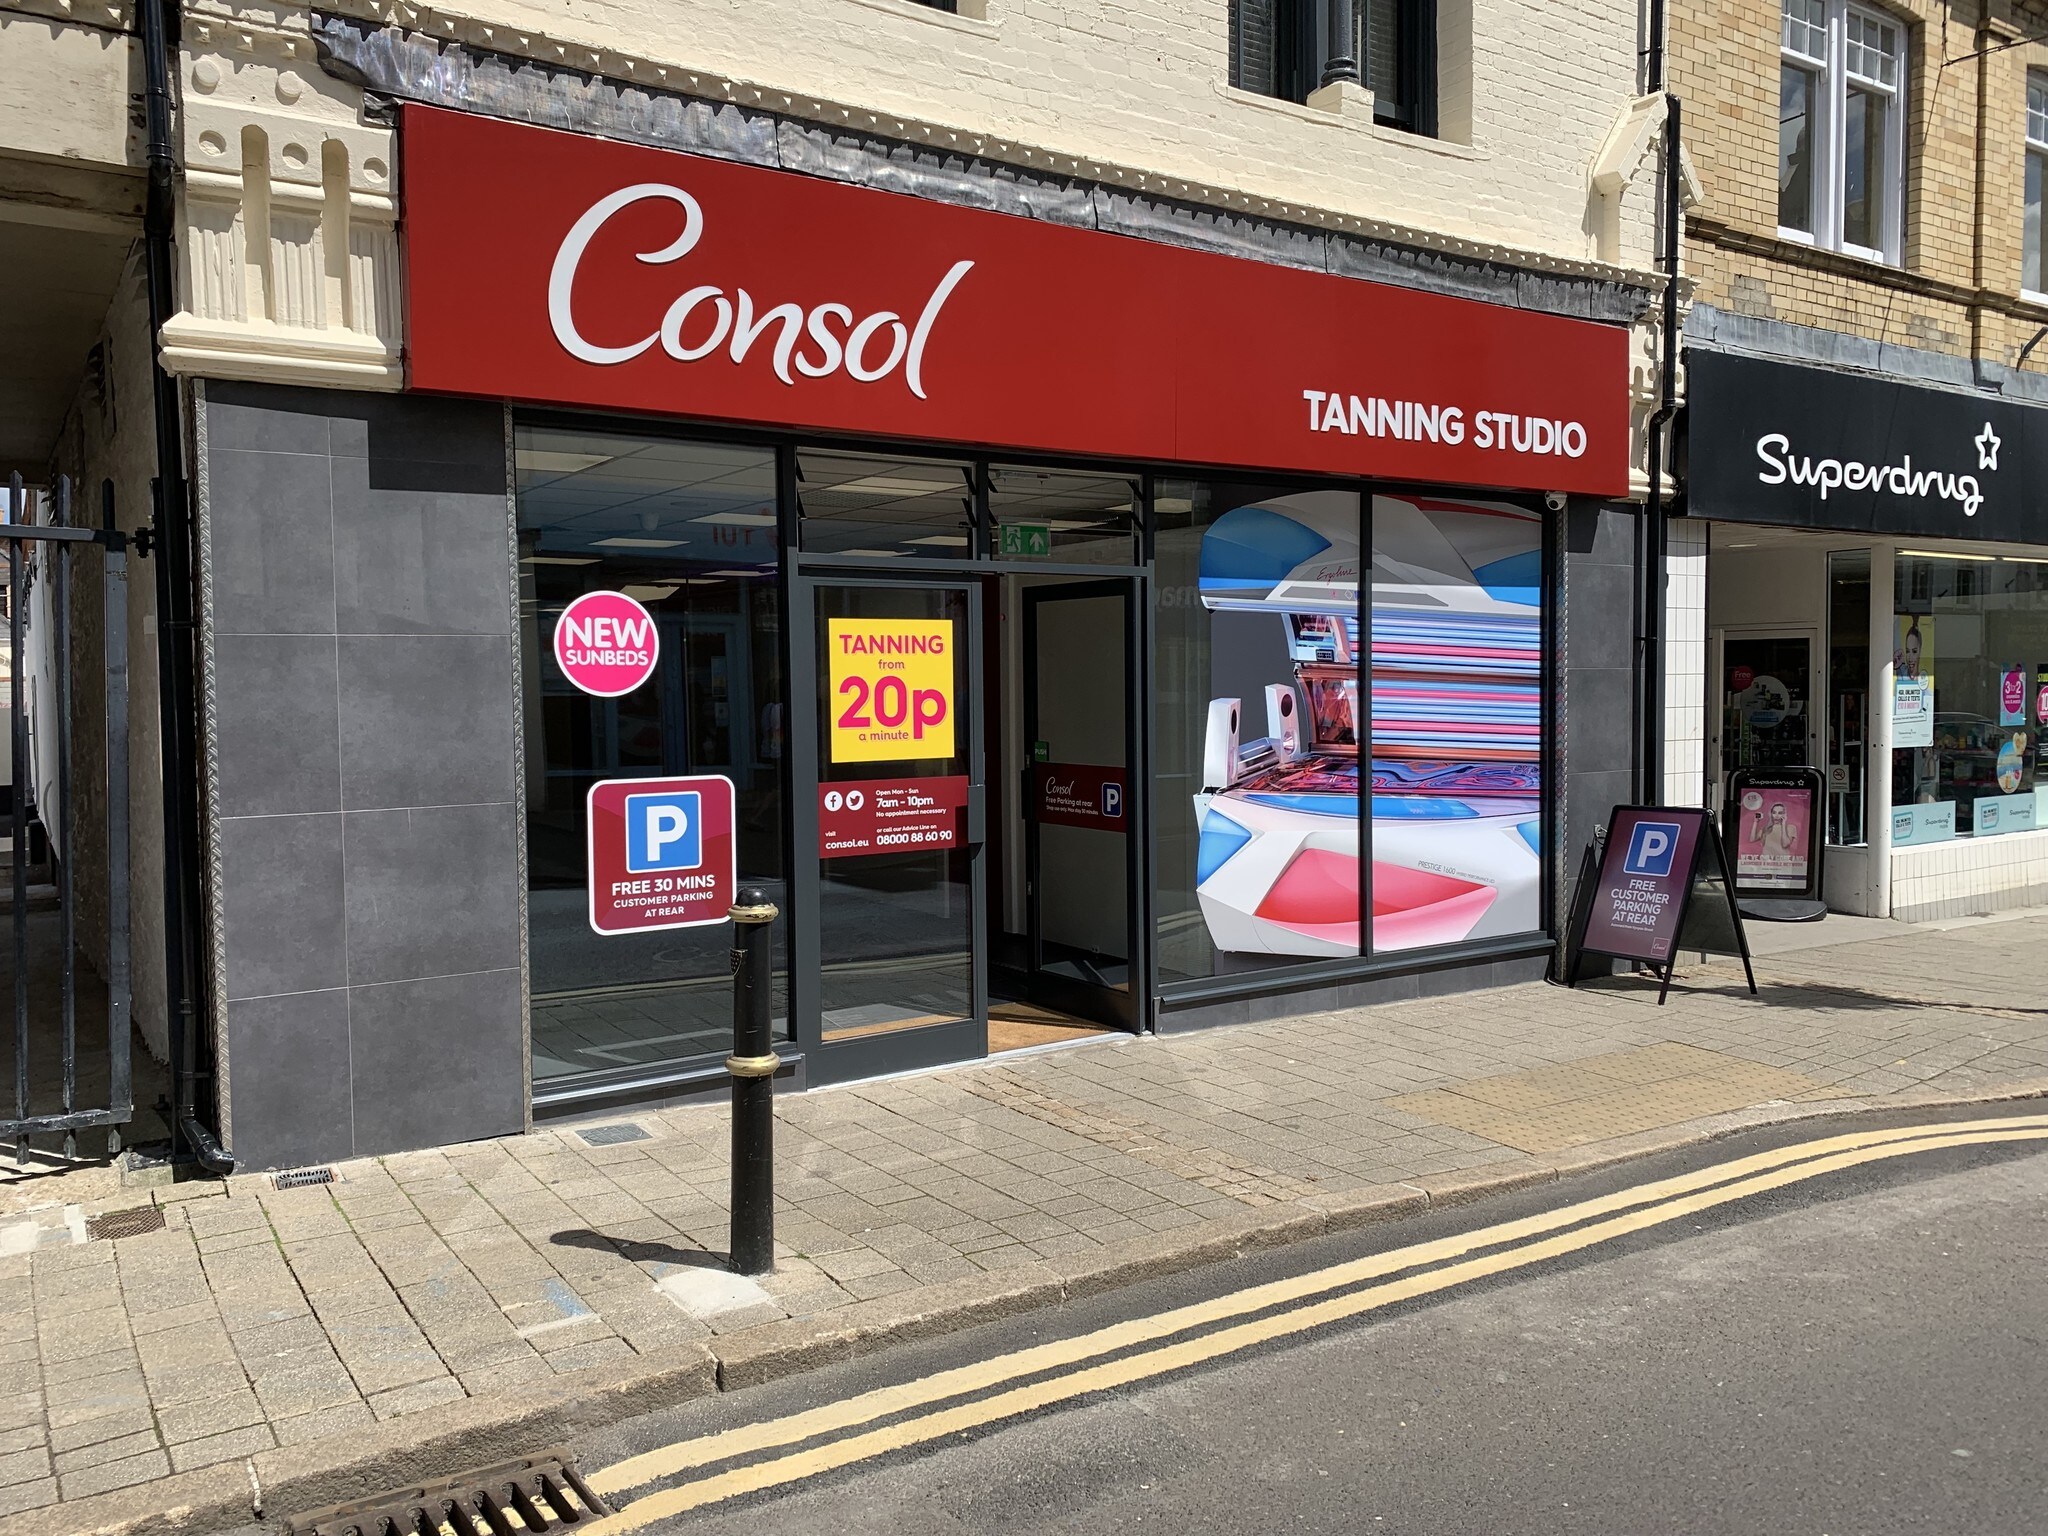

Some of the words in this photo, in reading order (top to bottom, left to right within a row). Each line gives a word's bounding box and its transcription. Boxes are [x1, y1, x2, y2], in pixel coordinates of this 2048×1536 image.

[548, 183, 975, 399] Consol
[1303, 389, 1465, 446] TANNING
[1473, 410, 1588, 459] STUDIO
[1756, 433, 1984, 517] Superdrug
[565, 616, 648, 649] NEW
[839, 634, 944, 655] TANNING
[565, 650, 649, 667] SUNBEDS
[878, 659, 905, 670] from
[838, 675, 947, 740] 20p
[858, 733, 867, 741] a
[870, 730, 909, 741] minute
[1035, 748, 1047, 756] PUSH
[1046, 776, 1074, 795] Consol
[1749, 778, 1795, 786] Superdrug
[876, 789, 891, 797] Open
[1106, 788, 1119, 812] P
[876, 797, 899, 808] 7am
[907, 796, 934, 808] 10pm
[1046, 796, 1056, 804] Free
[1057, 797, 1075, 807] Parking
[885, 809, 919, 818] appointment
[920, 808, 946, 816] necessary
[646, 805, 688, 862] P
[876, 834, 909, 846] 08000
[911, 832, 923, 842] 88
[925, 831, 938, 841] 60
[939, 830, 952, 841] 90
[825, 839, 869, 850] consol.eu
[1637, 830, 1669, 868] P
[1418, 860, 1442, 872] PRESTIGE
[1443, 866, 1456, 875] 1600
[612, 880, 650, 896] FREE
[654, 878, 673, 892] 30
[676, 874, 715, 890] MINS
[1629, 878, 1657, 892] FREE
[613, 896, 668, 908] CUSTOMER
[671, 891, 713, 904] PARKING
[1611, 888, 1670, 904] CUSTOMER
[645, 908, 657, 918] AT
[658, 906, 684, 917] REAR
[1613, 899, 1661, 915] PARKING
[1612, 911, 1628, 923] AT
[1628, 913, 1657, 926] REAR
